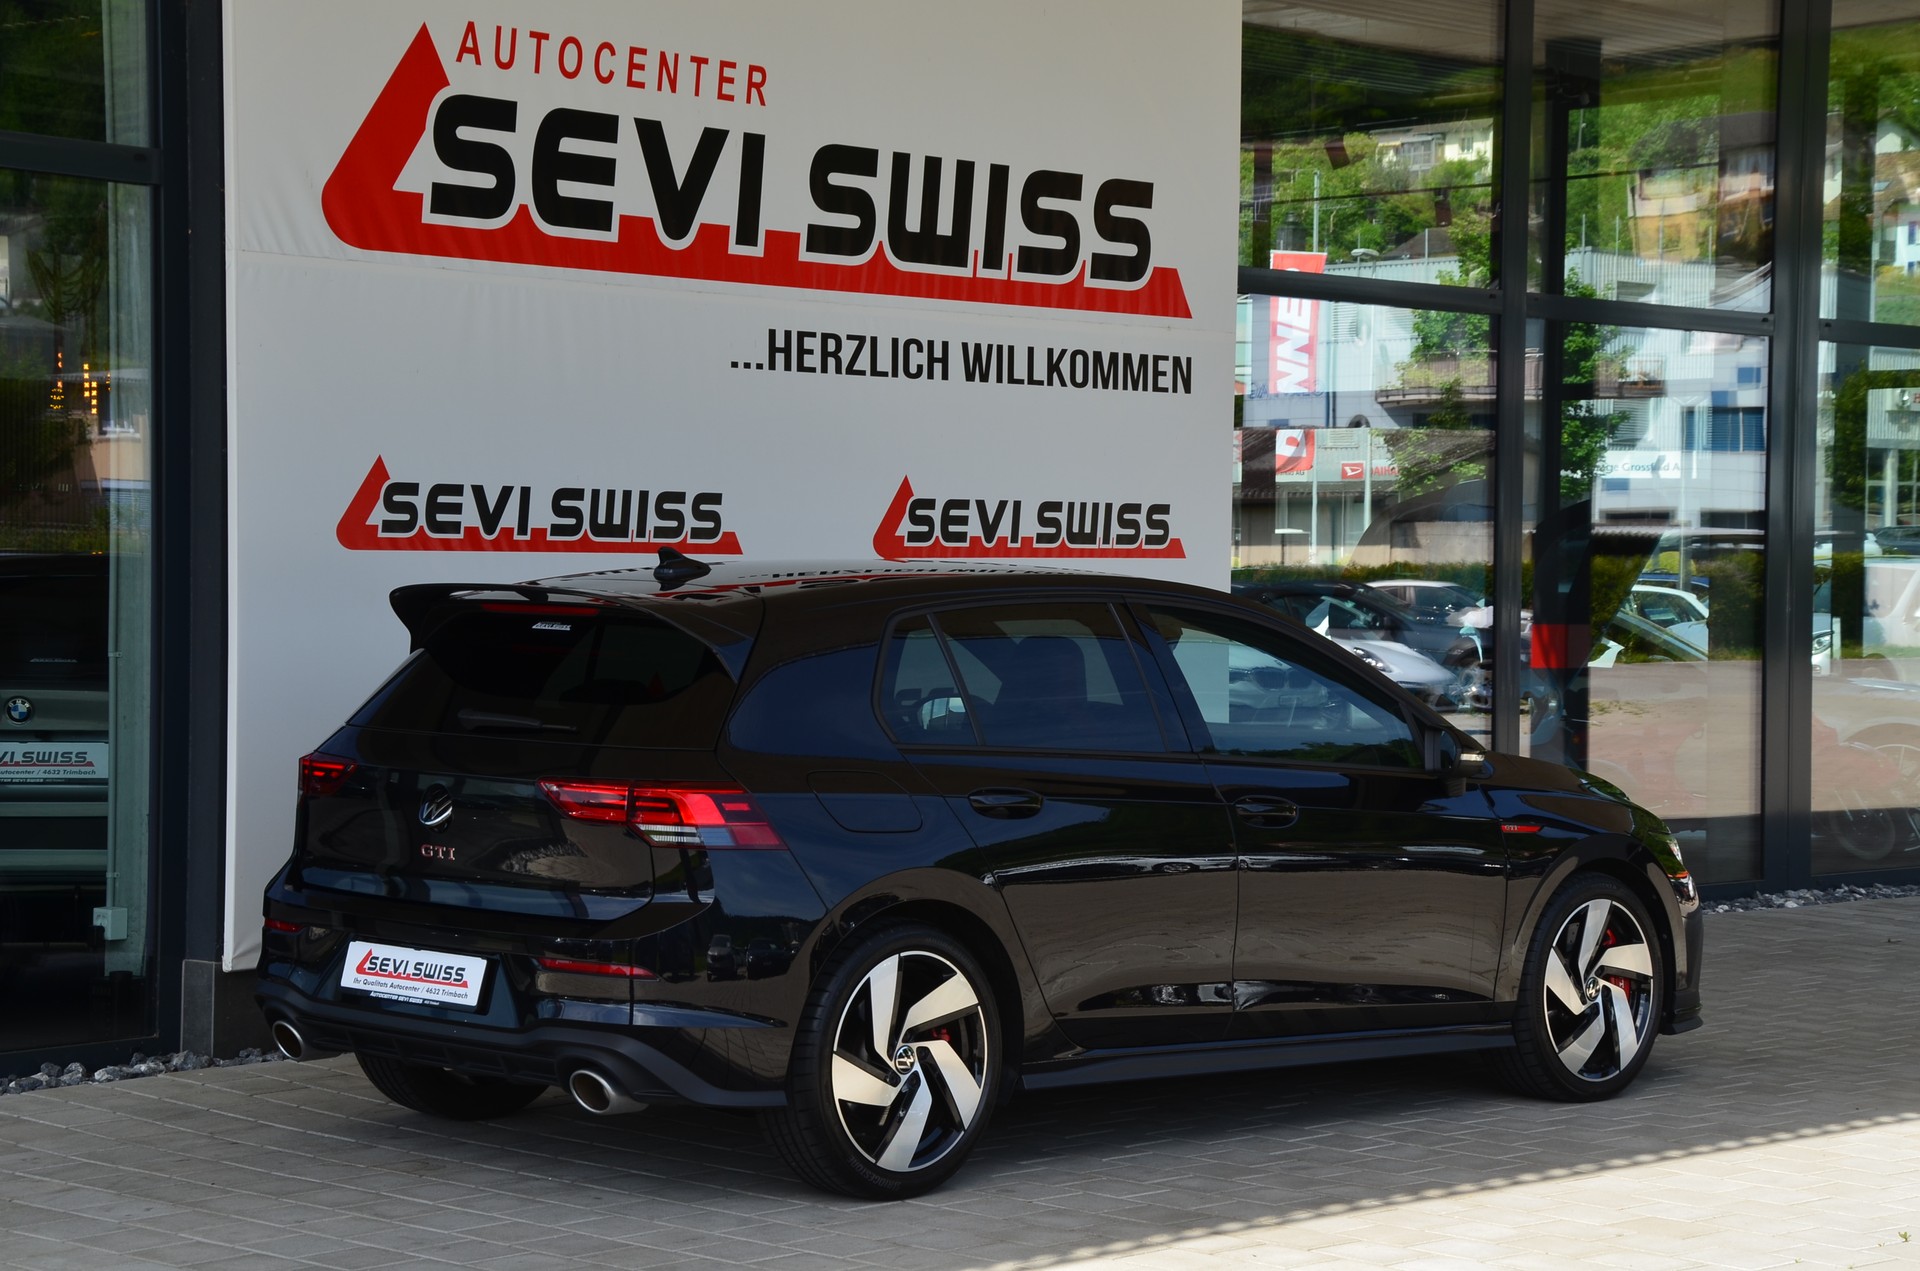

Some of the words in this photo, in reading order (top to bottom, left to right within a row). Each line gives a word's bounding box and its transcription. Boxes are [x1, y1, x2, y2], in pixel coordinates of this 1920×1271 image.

[455, 21, 768, 106] AUTOCENTER
[430, 94, 766, 248] SEVI
[805, 143, 1154, 283] SWISS
[730, 328, 949, 381] ...HERZLICH
[961, 341, 1192, 394] WILLKOMMEN
[1622, 462, 1669, 471] Grossfd
[381, 482, 531, 540] SEVI
[549, 487, 723, 541] SWISS
[906, 498, 1022, 546] SEVI
[1035, 501, 1171, 547] SWISS
[21, 751, 88, 764] SWISS
[421, 845, 456, 861] GTI
[352, 977, 362, 985] Ihr
[389, 982, 421, 992] Autocenter
[426, 987, 440, 995] 4632
[441, 988, 469, 1000] Trimbach
[367, 956, 409, 976] SEVI
[412, 961, 466, 983] SWISS
